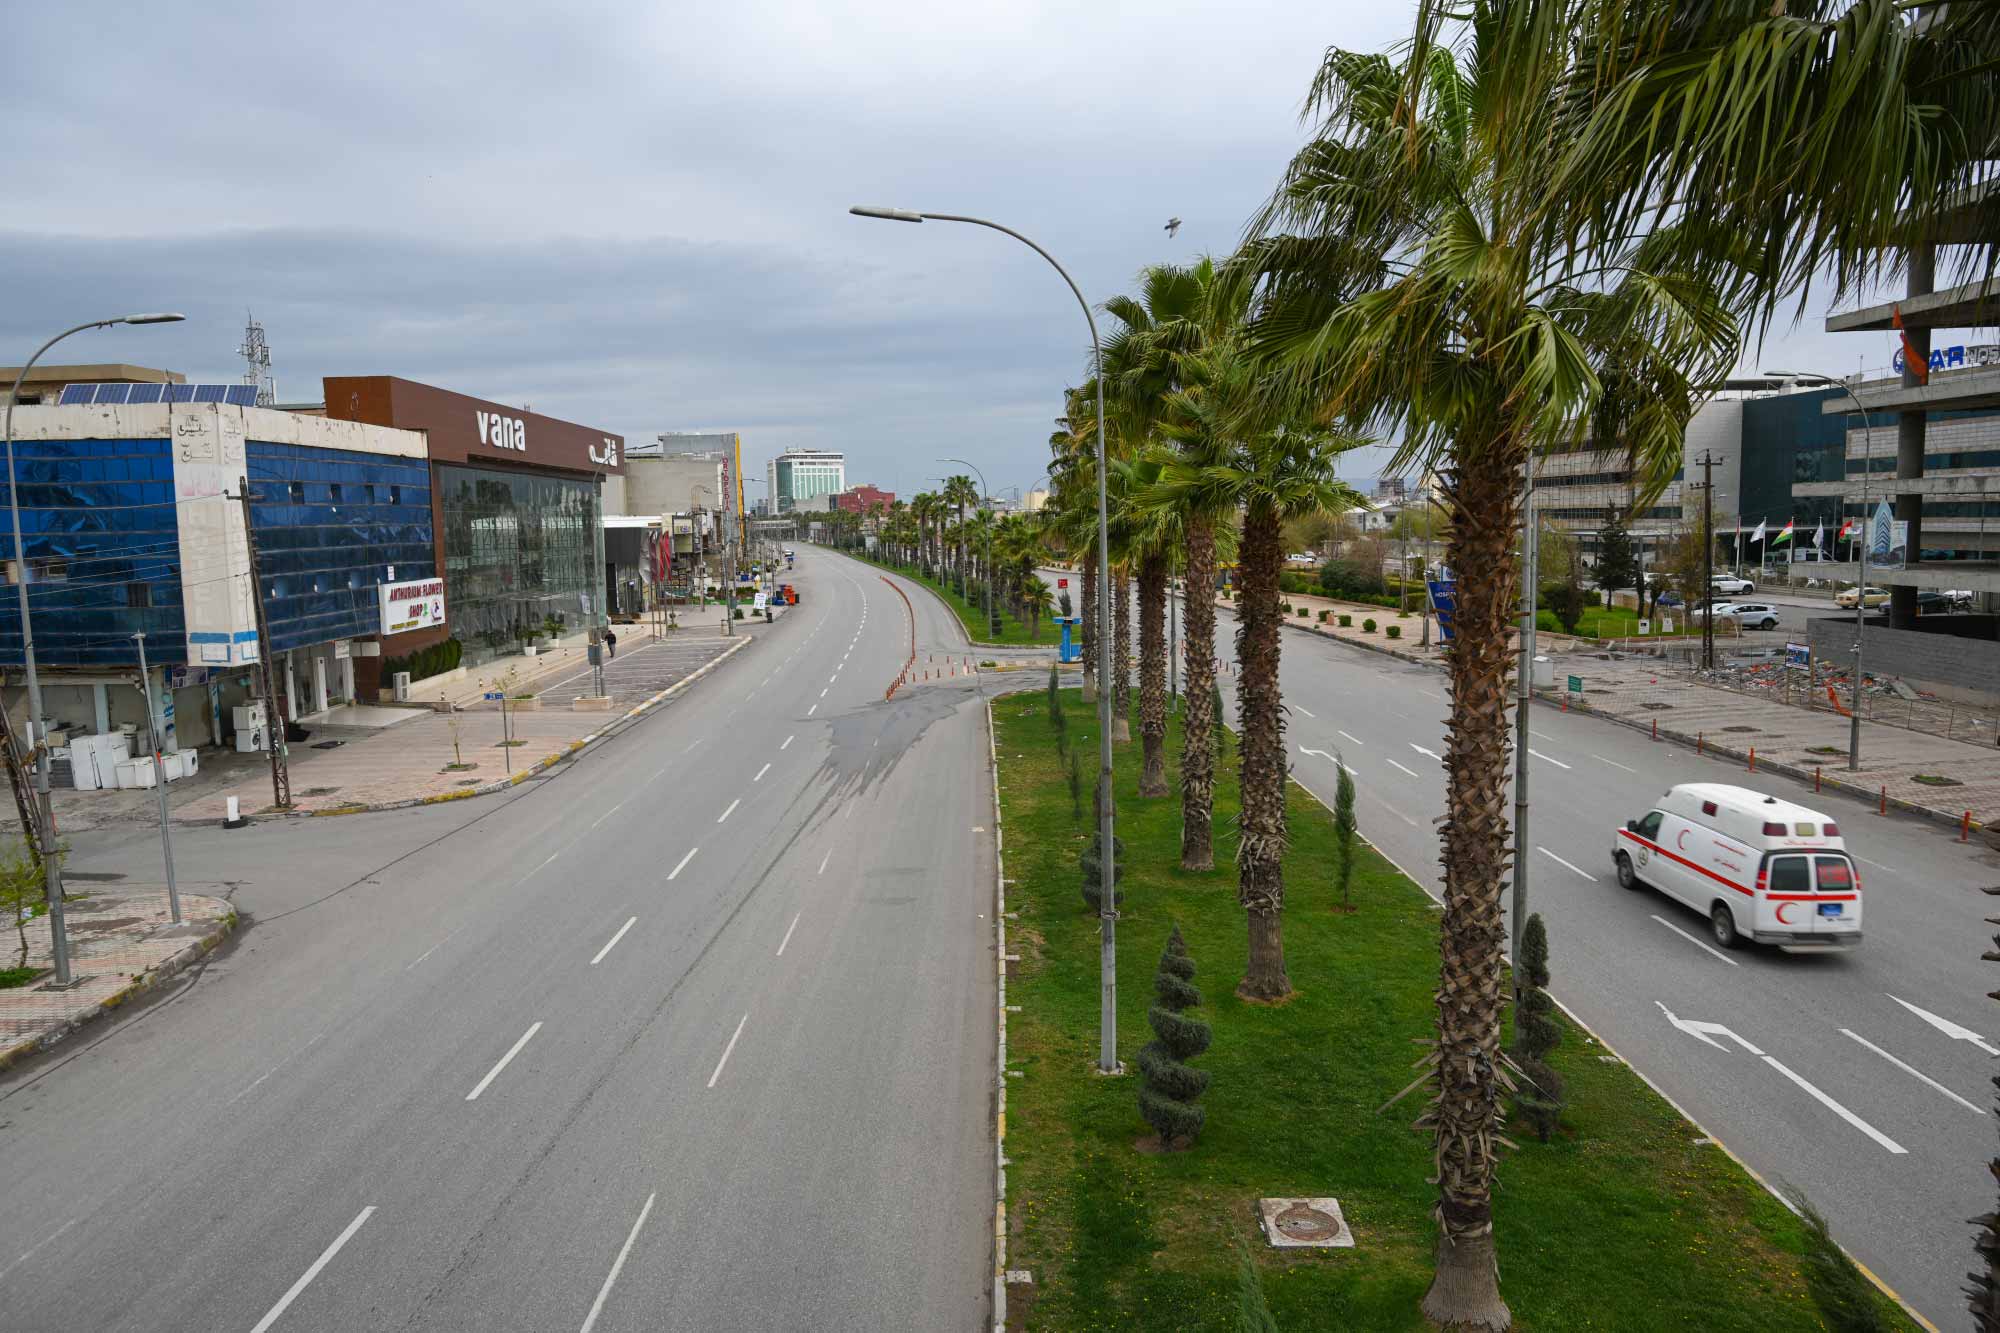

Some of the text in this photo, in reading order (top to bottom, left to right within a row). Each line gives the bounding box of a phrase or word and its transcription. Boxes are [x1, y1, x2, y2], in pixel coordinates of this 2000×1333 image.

[1928, 345, 1964, 369] AR
[476, 410, 526, 452] vana
[721, 457, 731, 512] ORTOPEDIA
[423, 582, 443, 597] FLOWER
[409, 604, 423, 617] SHOP
